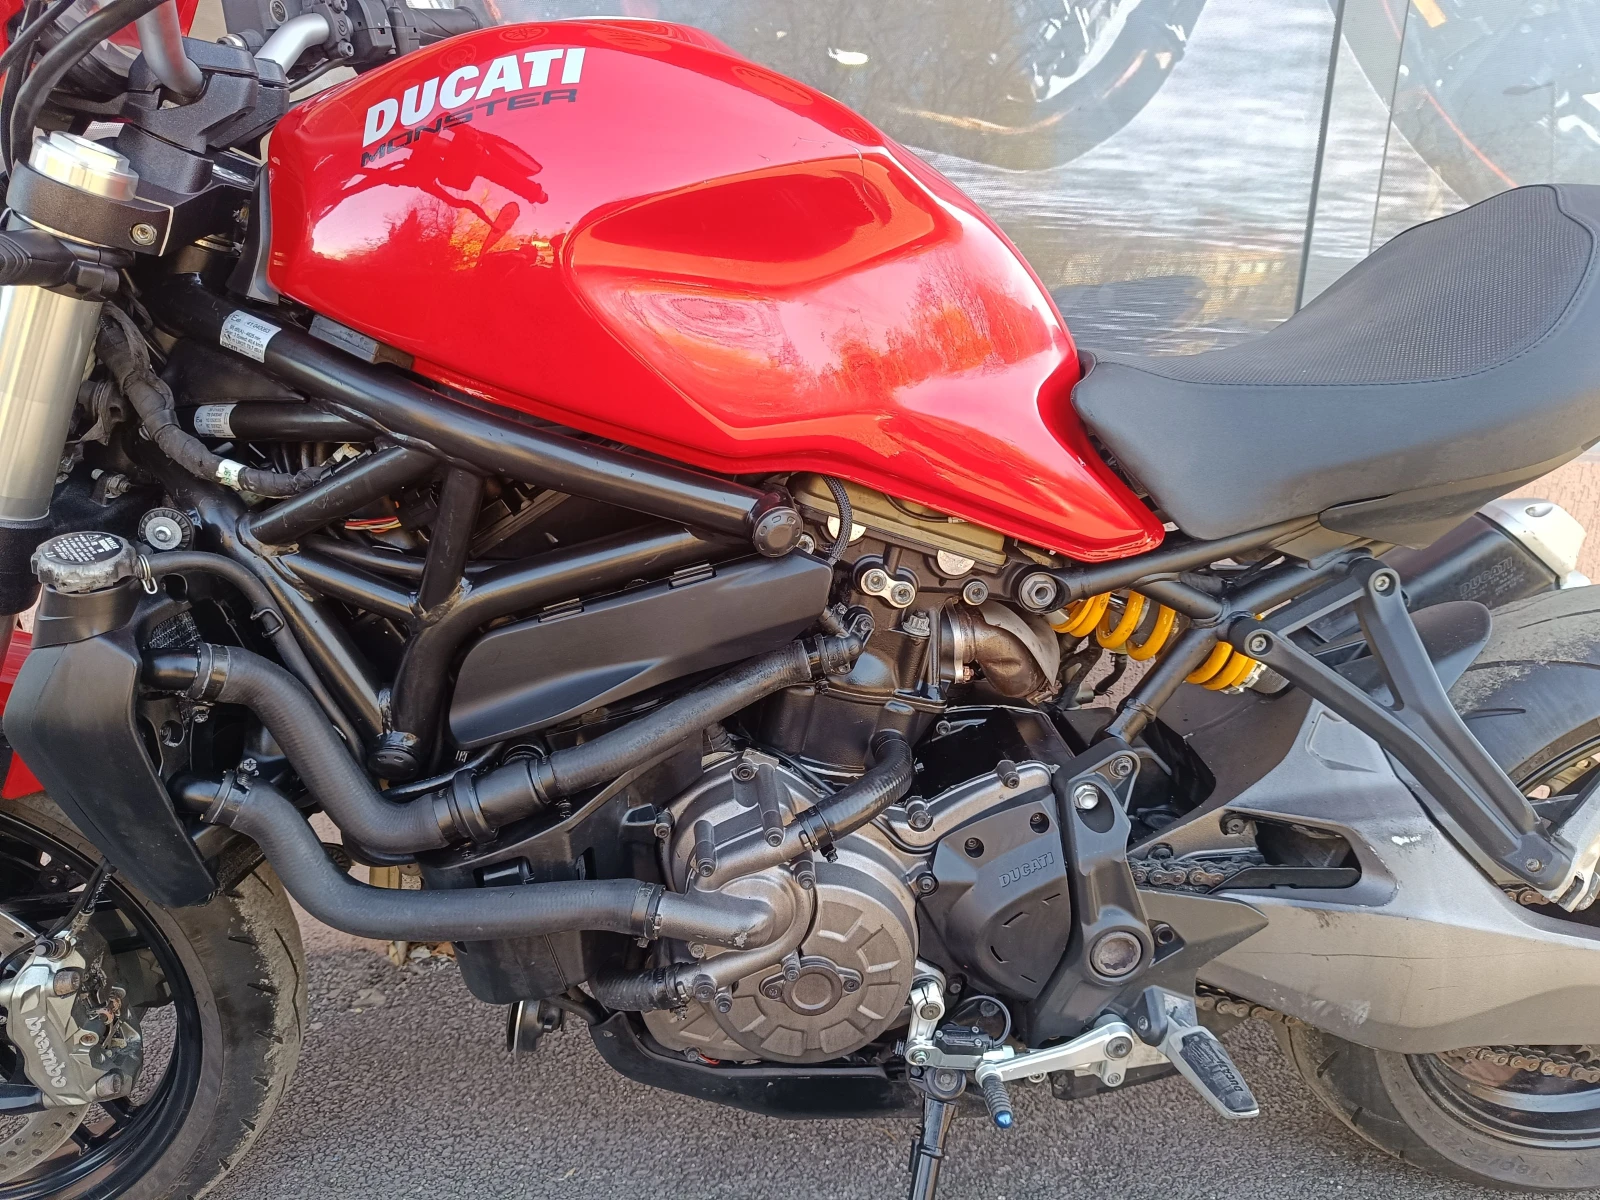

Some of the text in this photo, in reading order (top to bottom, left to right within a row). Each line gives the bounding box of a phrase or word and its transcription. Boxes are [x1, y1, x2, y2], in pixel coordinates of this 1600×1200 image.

[363, 48, 586, 148] DUCATI
[361, 88, 578, 167] MONSTER
[1460, 556, 1513, 597] DUCATI
[998, 851, 1055, 888] DUCATI
[25, 1015, 67, 1088] brembo
[1217, 1059, 1244, 1092] DUCATI
